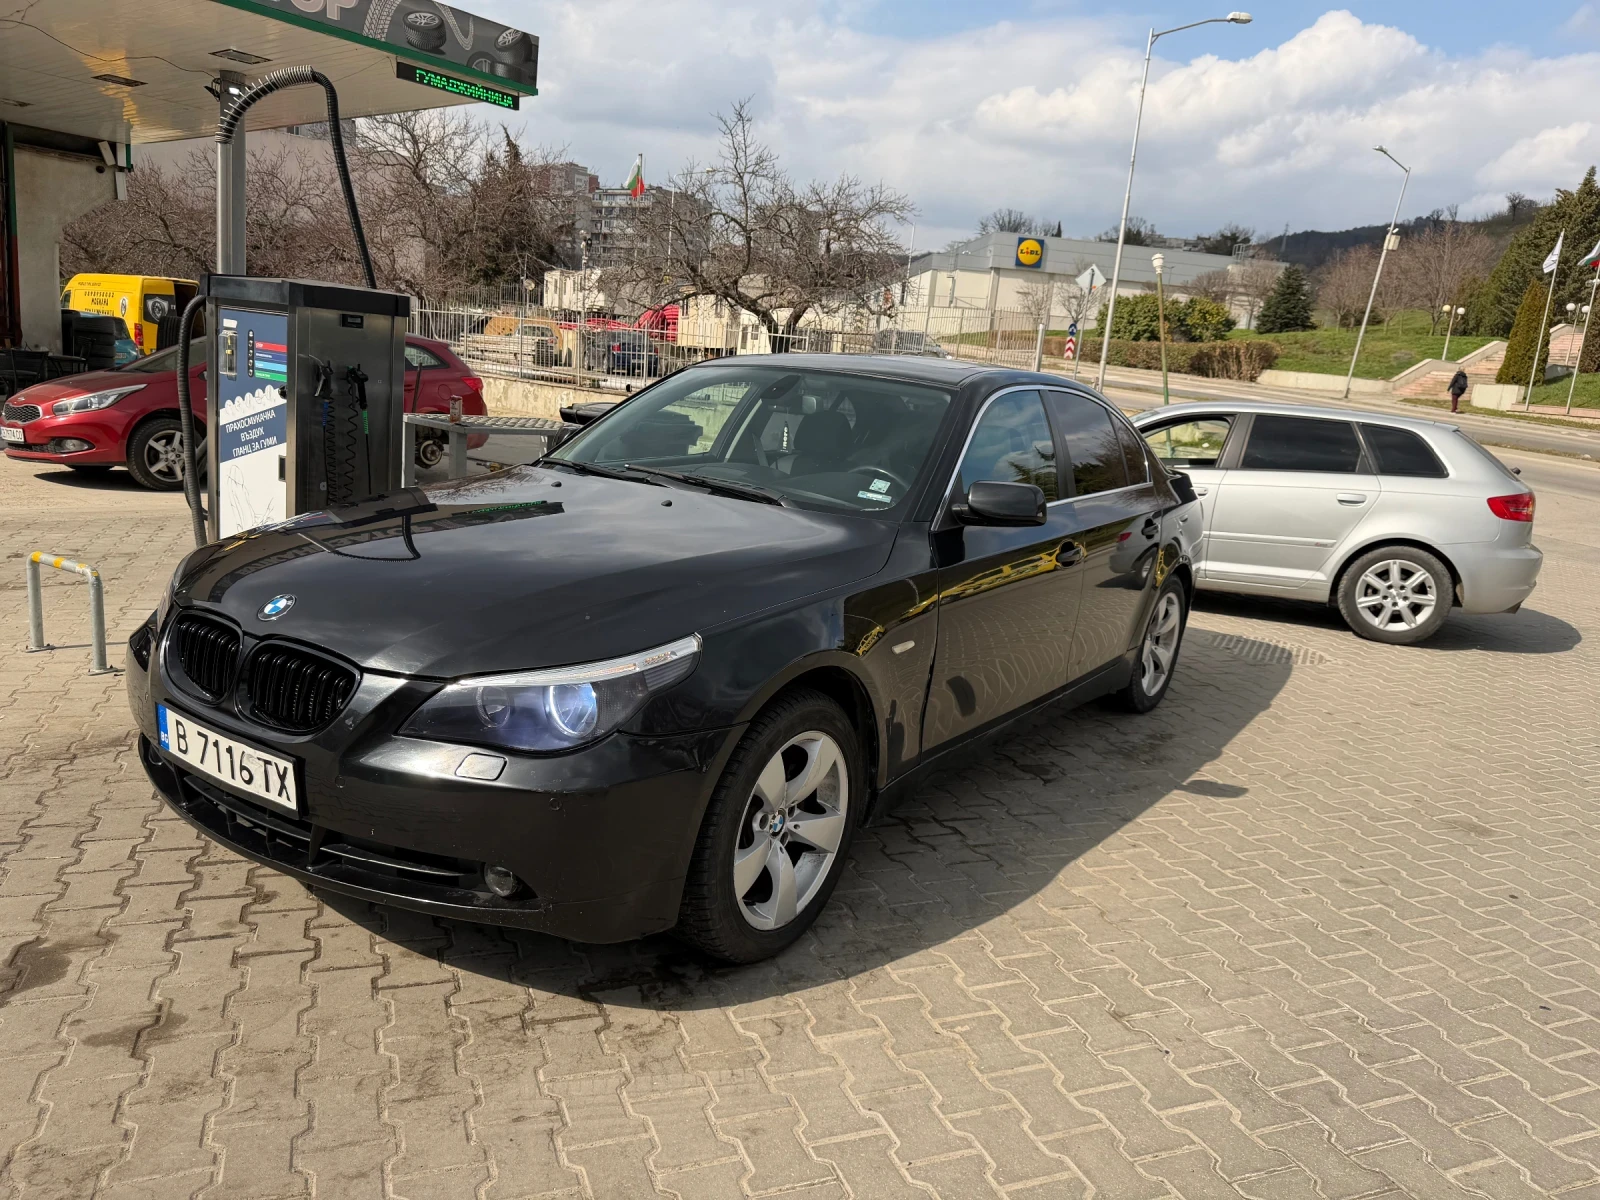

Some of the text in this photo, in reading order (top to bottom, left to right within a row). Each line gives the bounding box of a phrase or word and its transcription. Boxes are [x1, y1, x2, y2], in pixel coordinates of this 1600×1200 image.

[416, 69, 514, 108] ГУМАДЖИЙНИЦА
[225, 409, 276, 434] ПРАХОСМУКАЧКА
[240, 426, 265, 442] ВЪЗДУХ
[232, 435, 278, 457] ГЛАНЦ ЗА ГУМИ
[160, 731, 169, 743] BG
[175, 718, 188, 765] B
